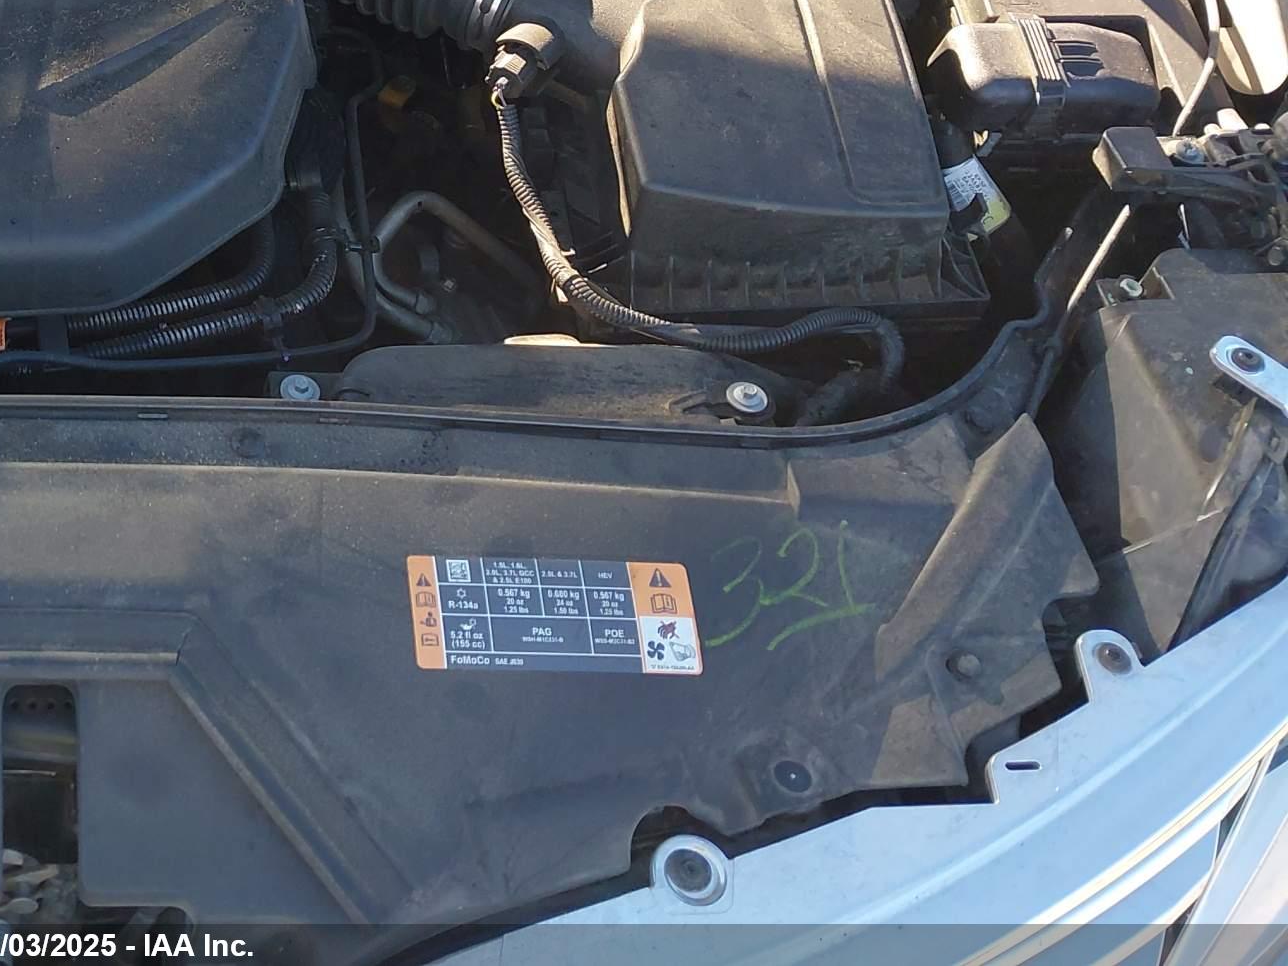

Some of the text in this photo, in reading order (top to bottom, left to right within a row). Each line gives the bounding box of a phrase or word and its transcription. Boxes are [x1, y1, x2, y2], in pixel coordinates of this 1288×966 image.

[704, 519, 877, 651] 321
[497, 589, 531, 599] 0.567 kg
[569, 590, 580, 600] kg
[593, 591, 625, 602] 0.567 kg
[448, 600, 479, 610] R-134a
[506, 597, 514, 605] 20
[450, 630, 483, 640] 5.2 fl oz
[531, 627, 552, 636] PAG
[604, 629, 625, 638] POE
[451, 639, 486, 650] (155 cc)
[450, 655, 490, 665] FoMoCo
